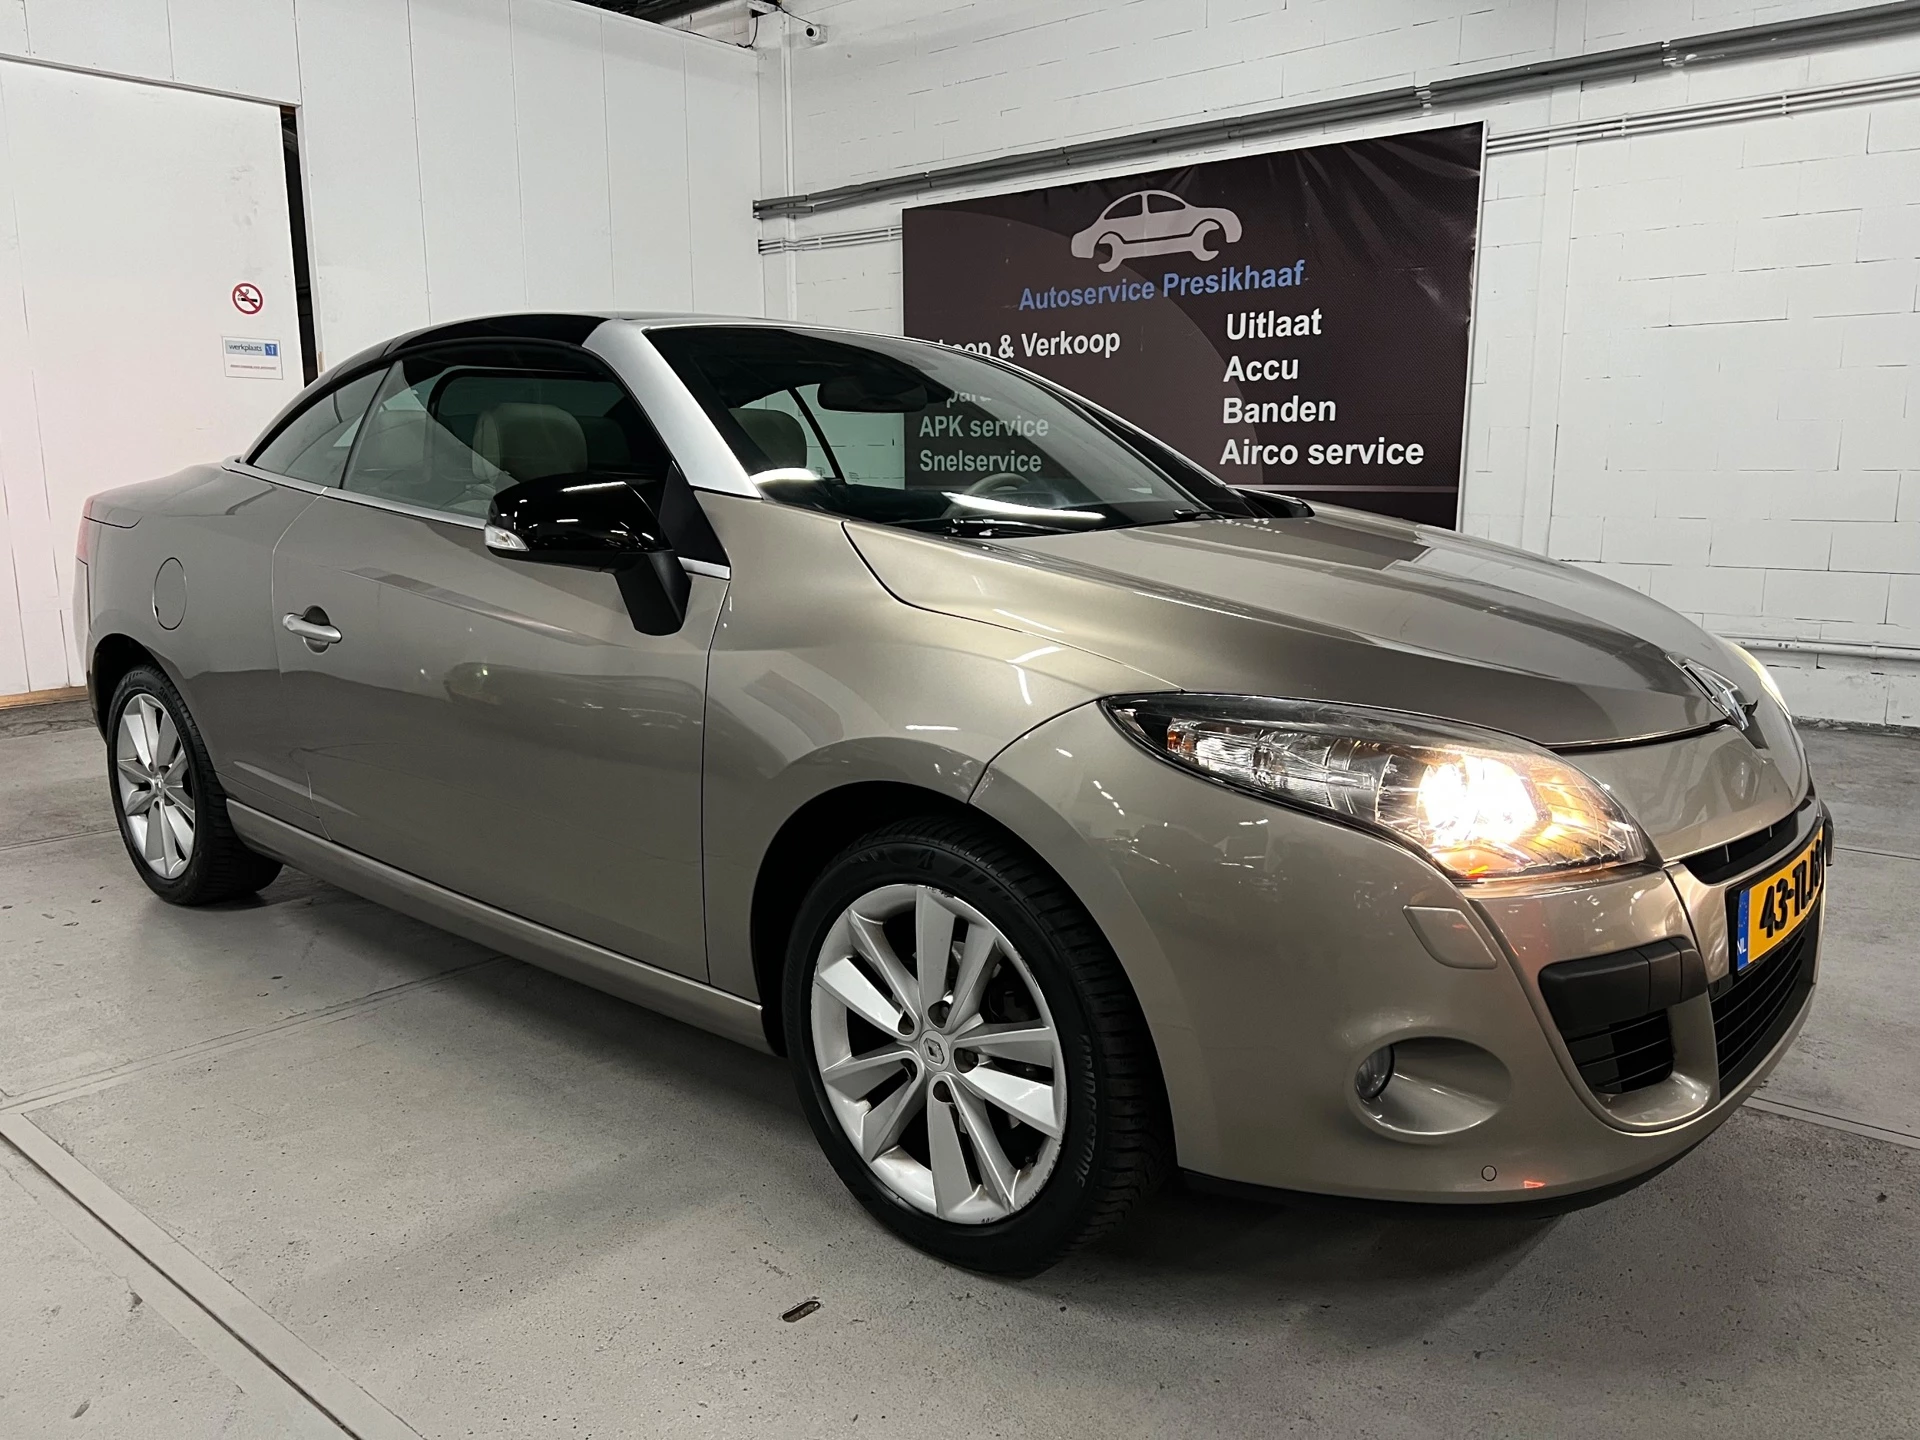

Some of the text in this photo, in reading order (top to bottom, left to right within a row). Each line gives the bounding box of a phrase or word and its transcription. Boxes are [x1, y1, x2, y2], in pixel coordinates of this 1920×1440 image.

[1018, 259, 1305, 311] Autoservice Presikhaaf
[1226, 308, 1322, 341] Uitlaat
[228, 343, 263, 353] werkplaats
[998, 334, 1015, 358] &
[1020, 331, 1121, 358] Verkoop
[1222, 355, 1299, 382] Accu
[1222, 395, 1336, 424] Banden
[919, 415, 1049, 437] APK service
[919, 449, 1042, 472] Snelservice
[1219, 436, 1424, 465] Airco service
[1736, 937, 1747, 955] NL
